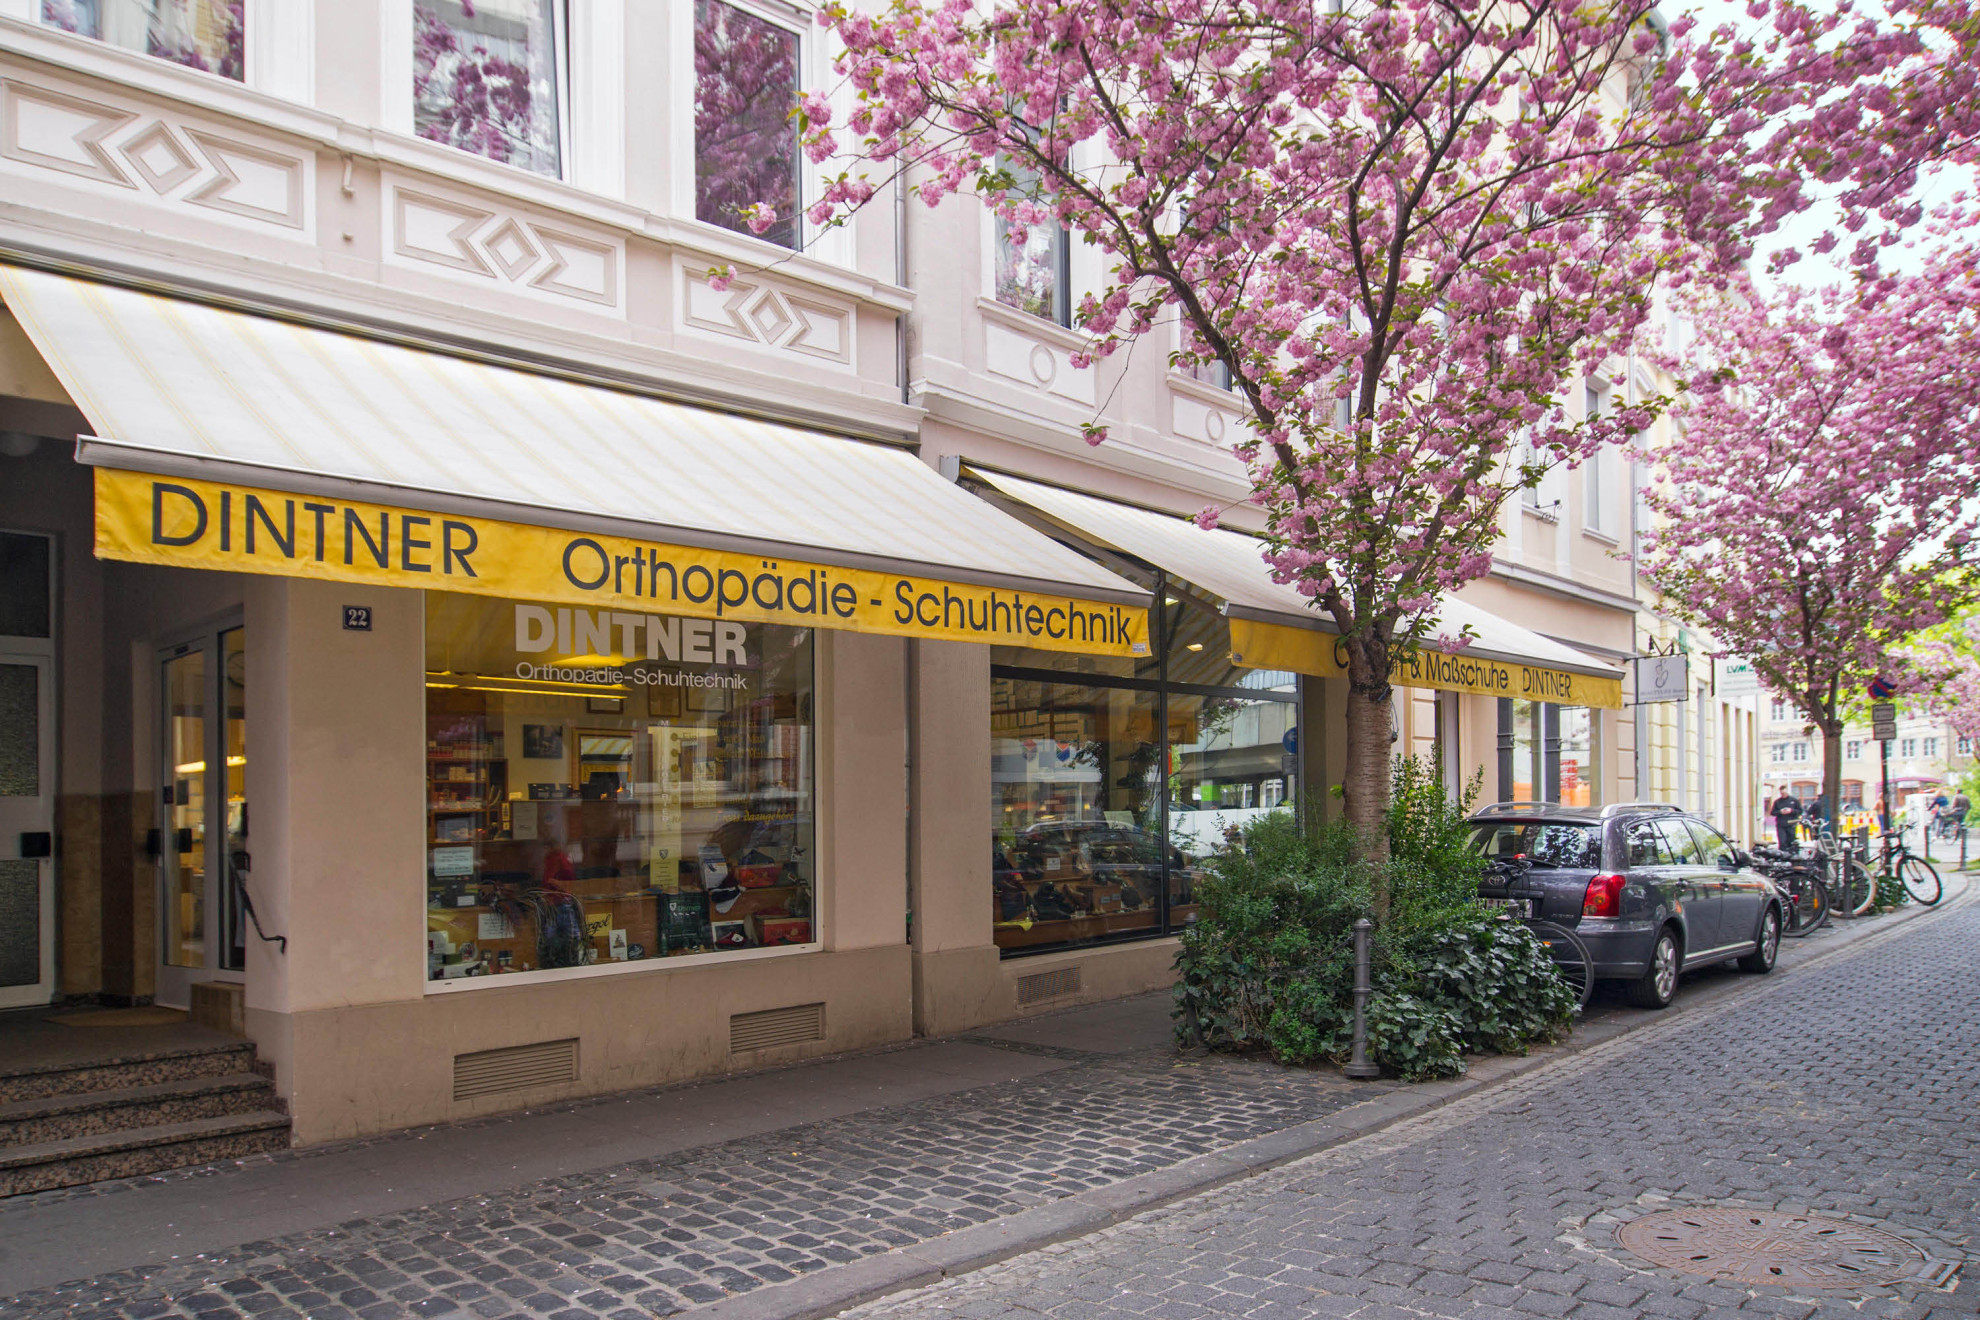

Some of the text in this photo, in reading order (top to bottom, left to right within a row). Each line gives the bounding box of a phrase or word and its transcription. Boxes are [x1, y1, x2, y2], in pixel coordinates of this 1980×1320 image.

[151, 481, 479, 578] DINTNER
[562, 537, 858, 617] Orthopädie
[894, 580, 1132, 646] Schuhtechnik
[347, 608, 368, 626] 22
[514, 603, 748, 666] DINTNER
[515, 661, 748, 690] Orthopädie-Schuhtechnik
[1425, 652, 1509, 690] Maßschuhe
[1522, 666, 1572, 700] DINTNER
